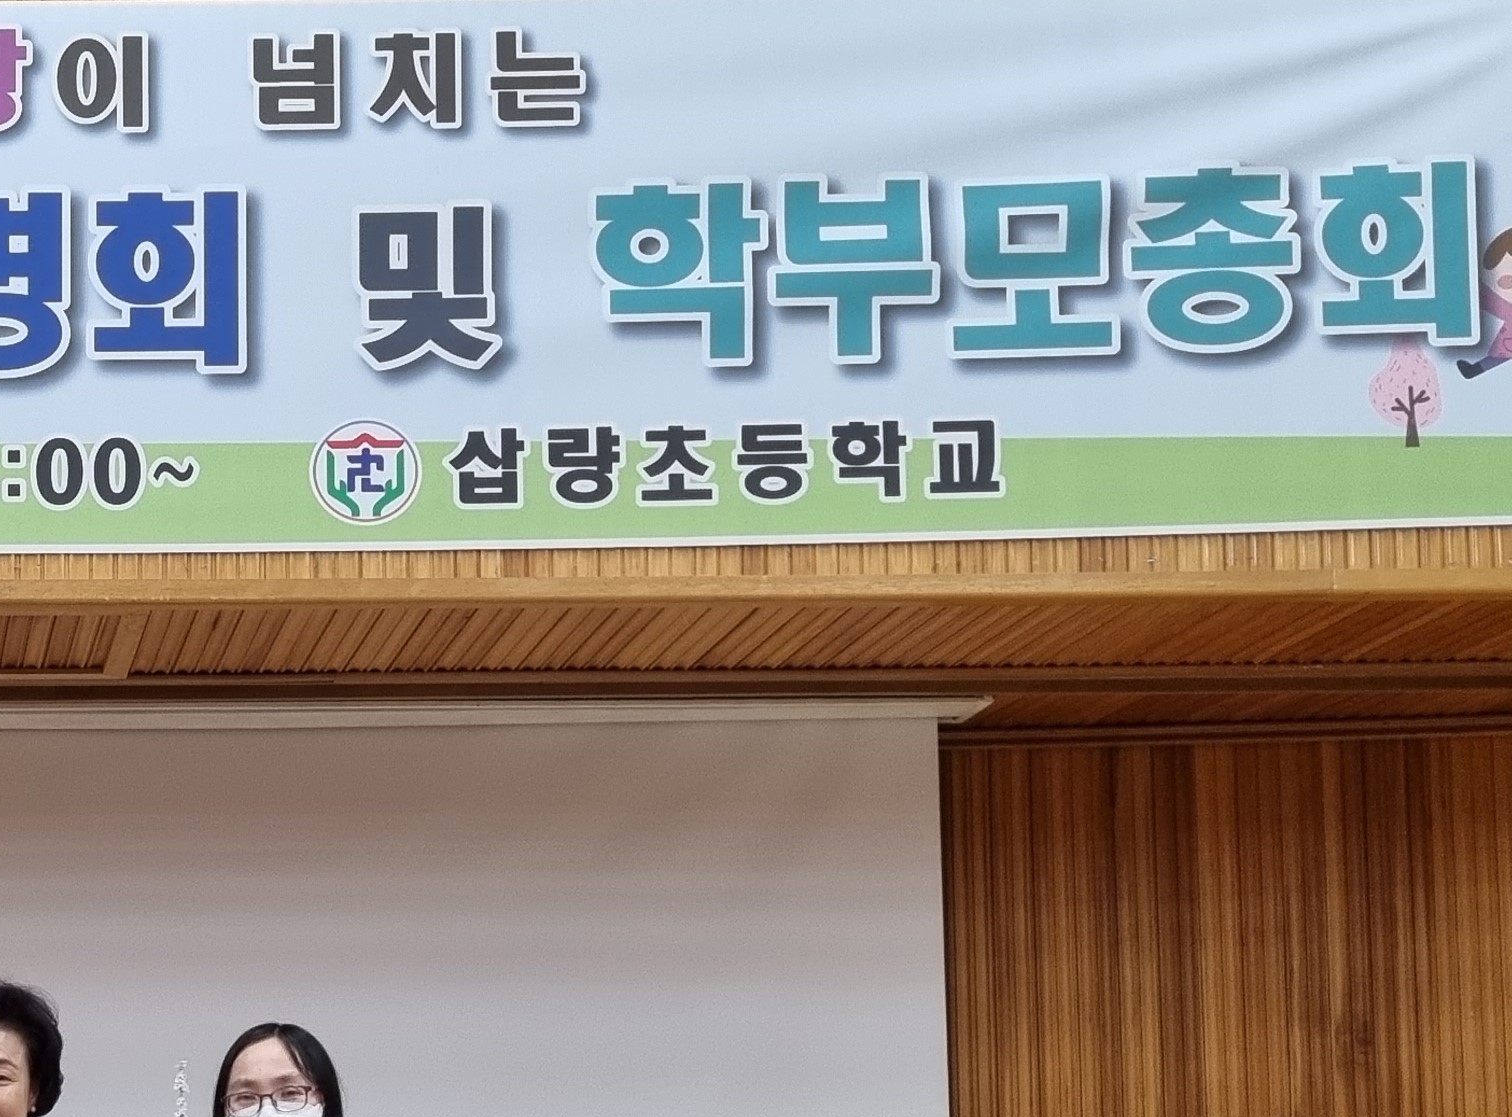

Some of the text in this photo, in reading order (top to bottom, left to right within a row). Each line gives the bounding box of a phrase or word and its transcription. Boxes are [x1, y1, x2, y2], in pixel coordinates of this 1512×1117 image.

[252, 31, 581, 125] 넘치는
[358, 206, 493, 363] 및
[594, 161, 1472, 359] 학부모총회
[449, 420, 1000, 504] 삽량초등학교
